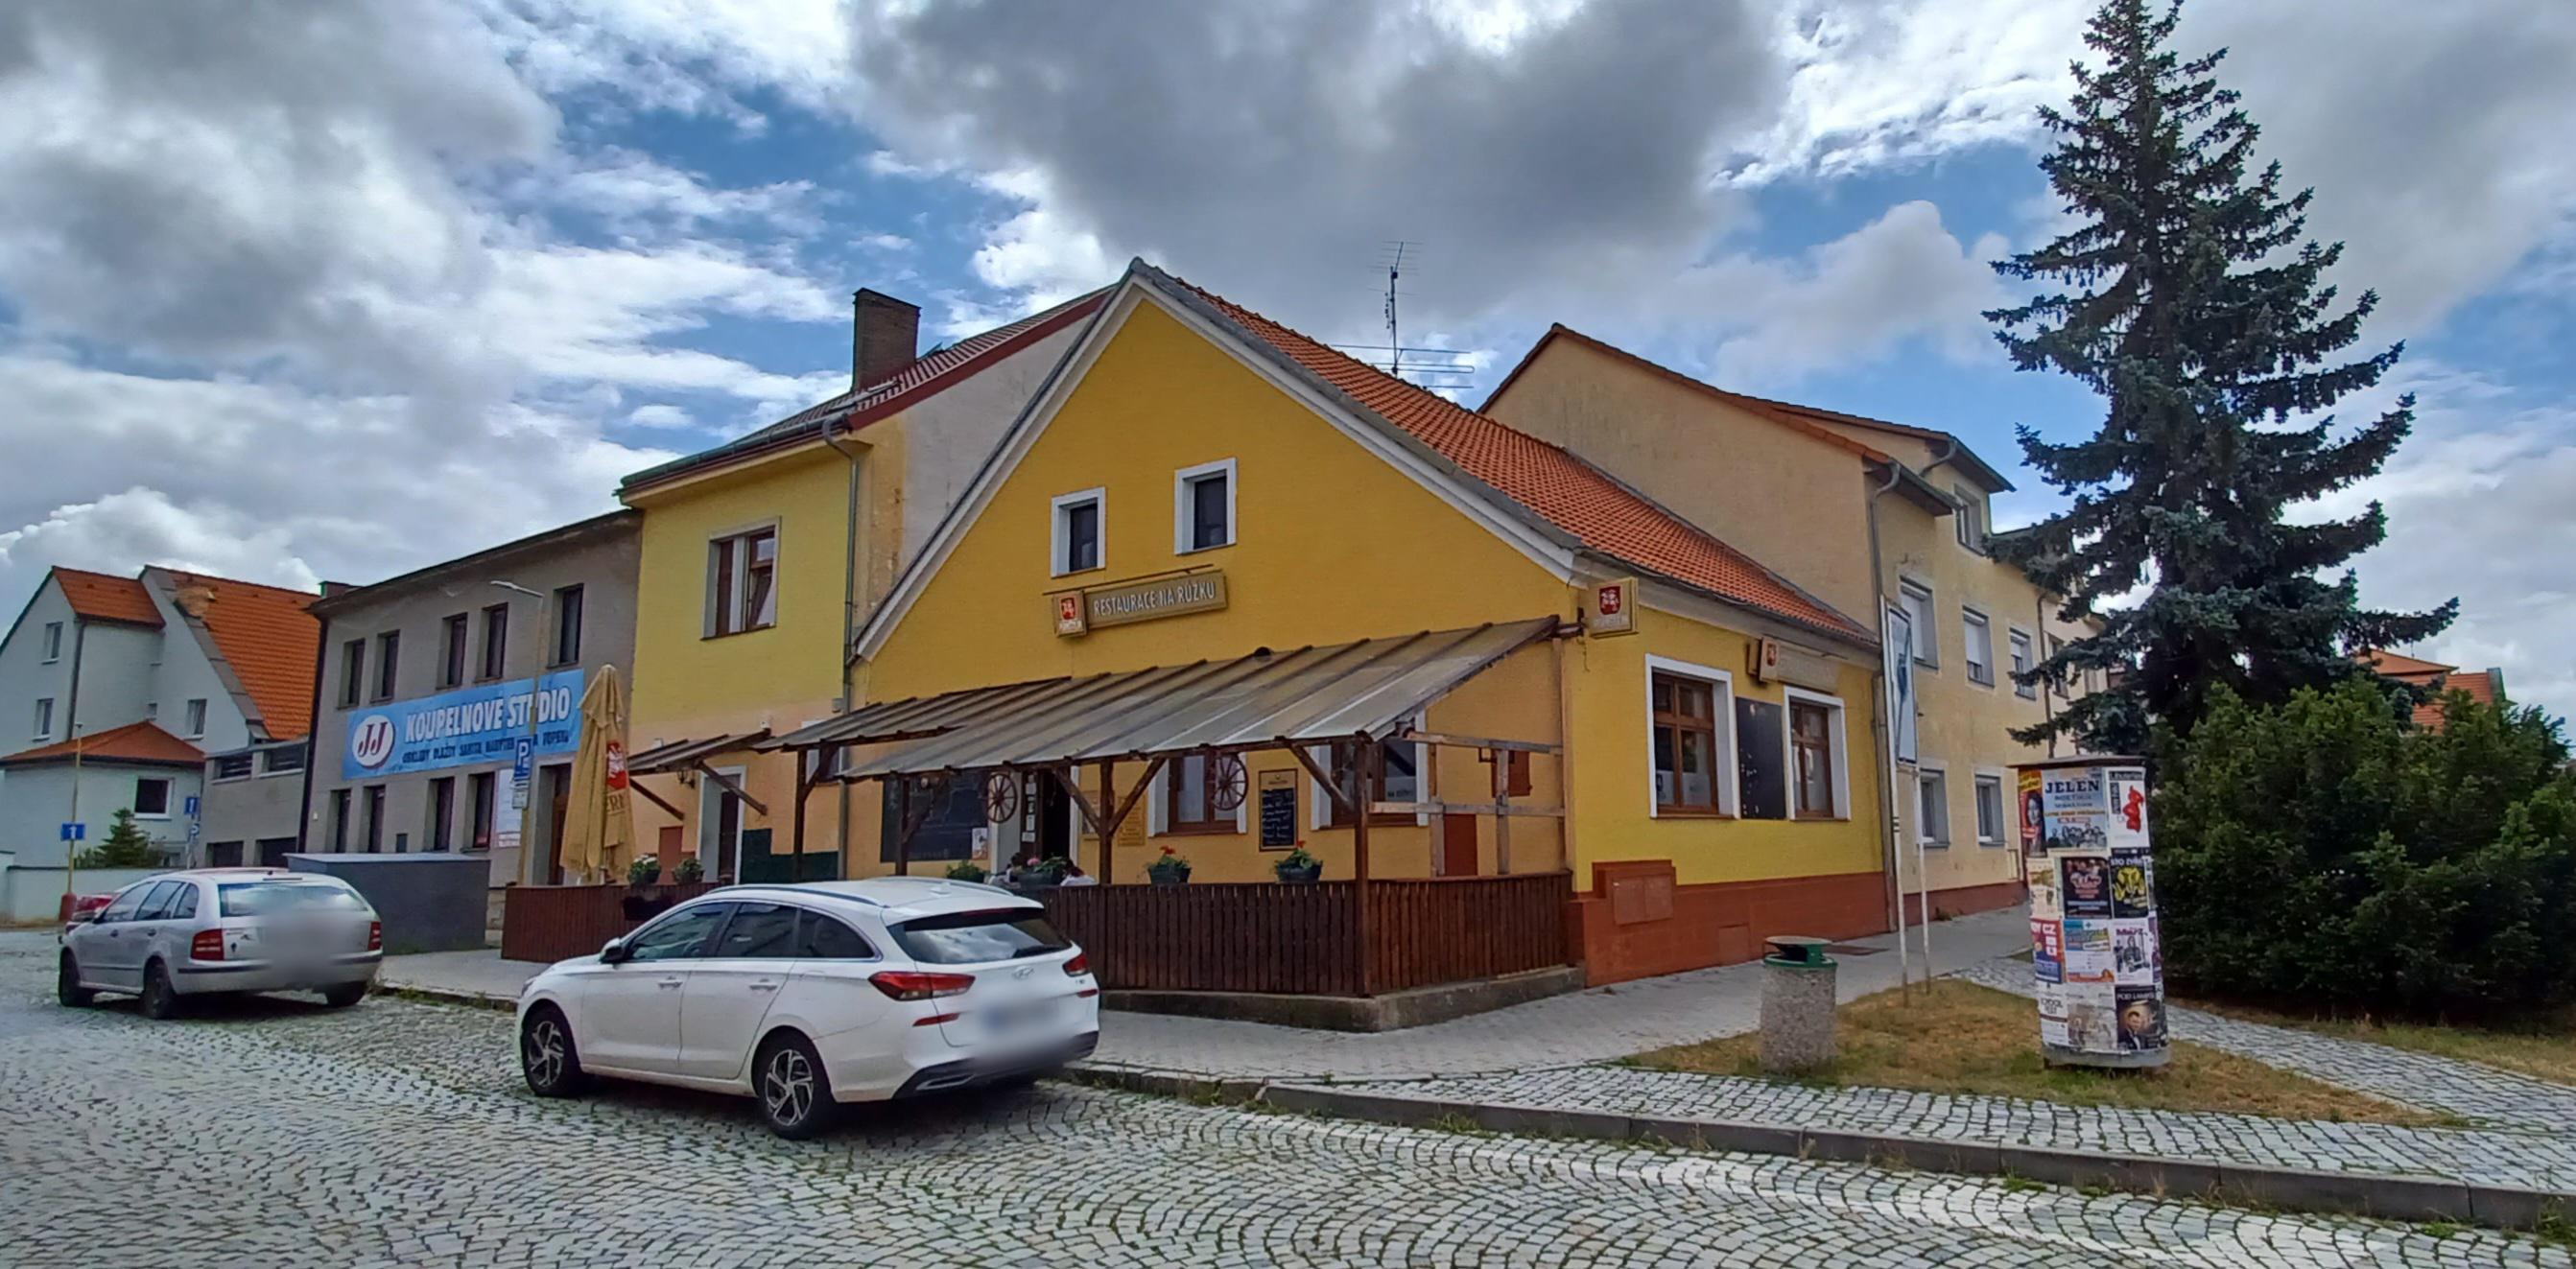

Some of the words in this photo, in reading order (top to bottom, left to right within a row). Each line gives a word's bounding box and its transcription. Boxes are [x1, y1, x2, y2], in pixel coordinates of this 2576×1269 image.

[1093, 590, 1156, 617] RESTAURACE
[1159, 588, 1175, 607] NA
[518, 741, 529, 766] P
[2045, 780, 2100, 794] JELEN
